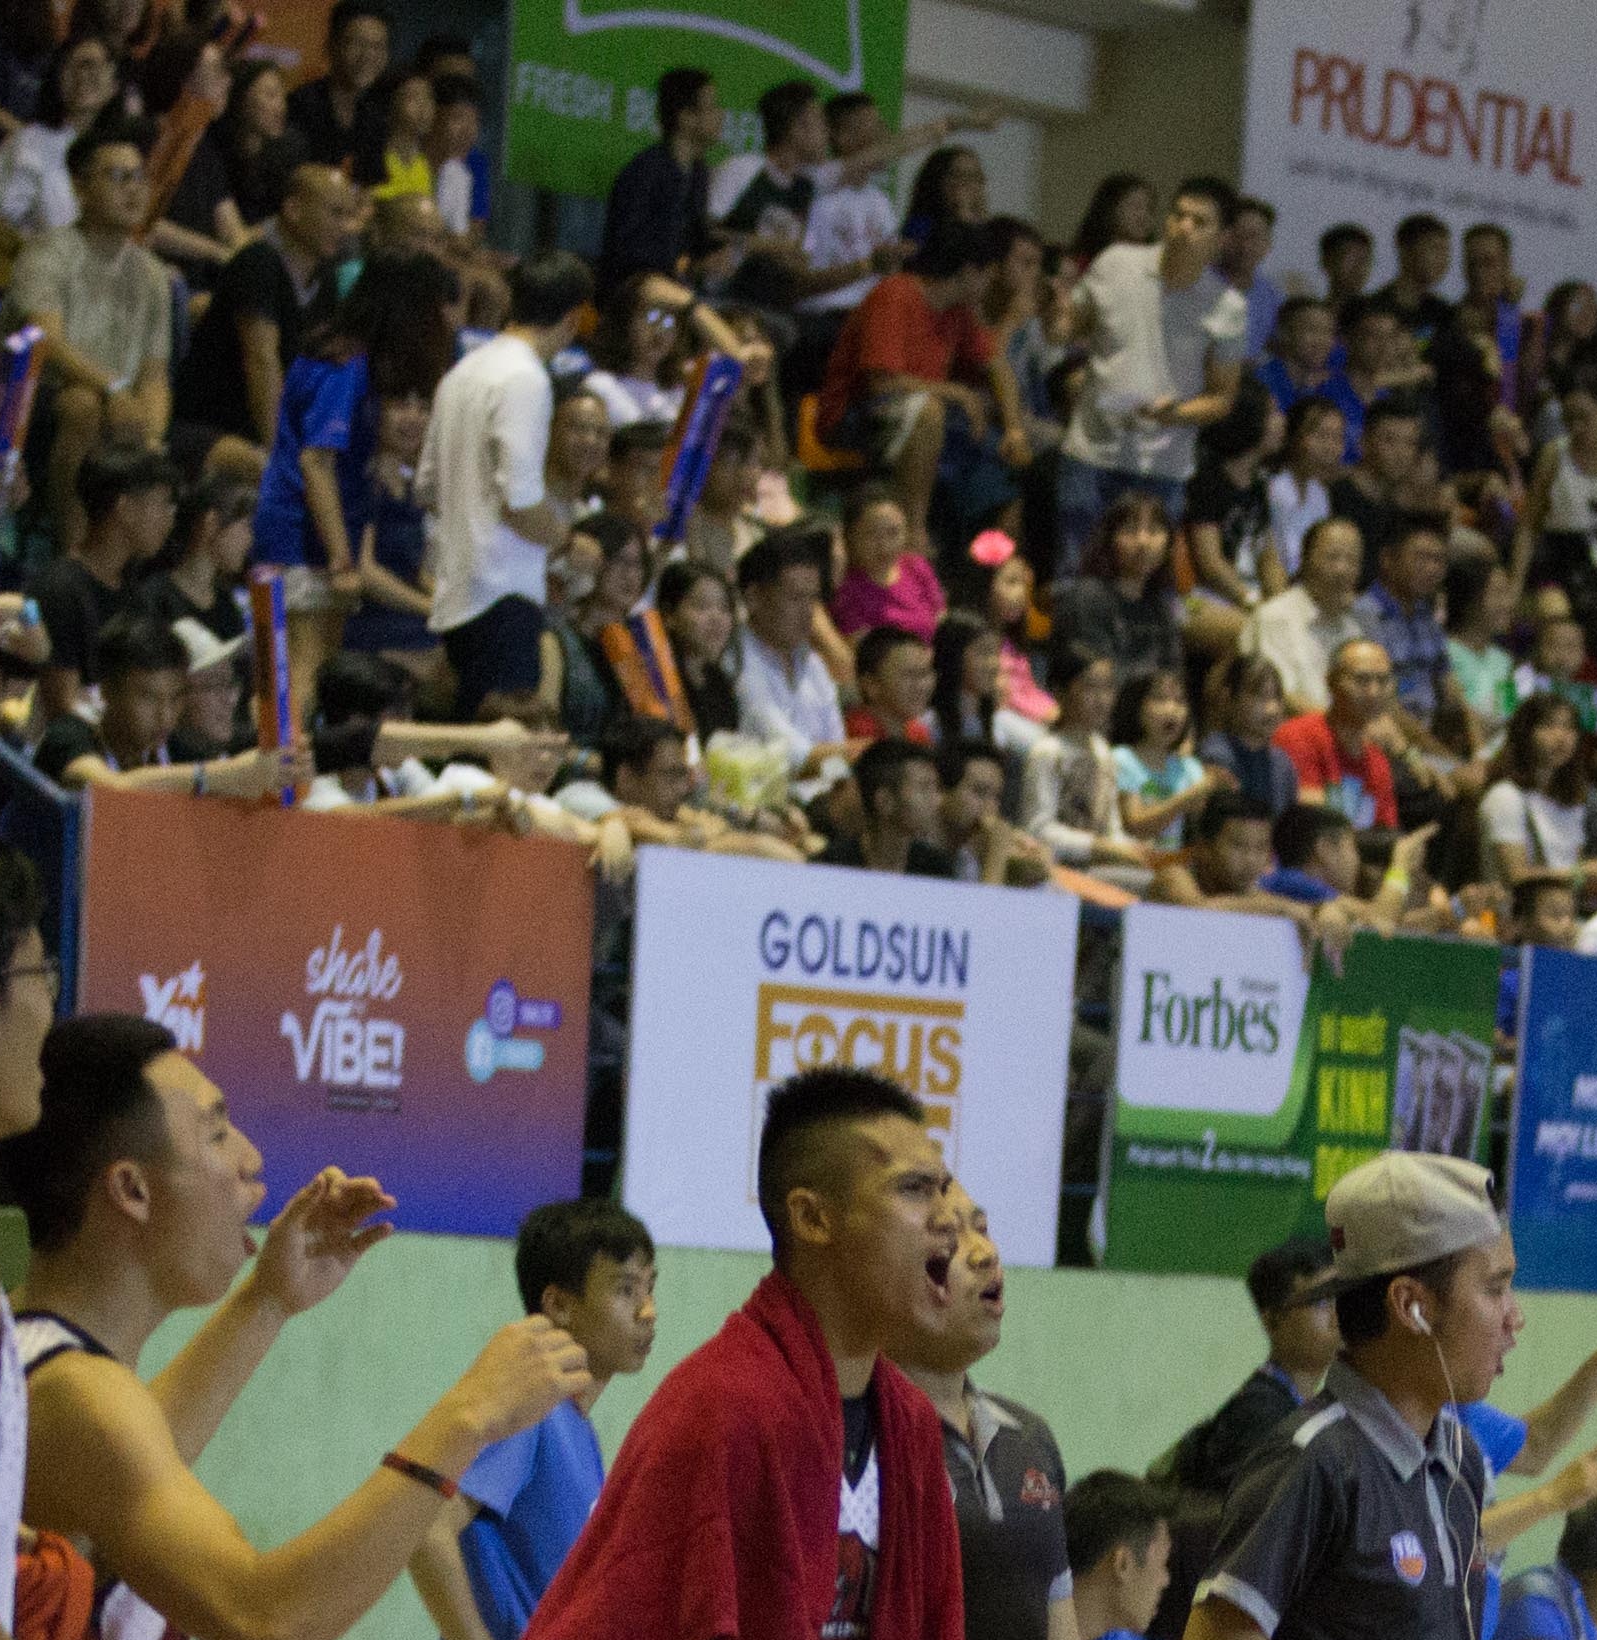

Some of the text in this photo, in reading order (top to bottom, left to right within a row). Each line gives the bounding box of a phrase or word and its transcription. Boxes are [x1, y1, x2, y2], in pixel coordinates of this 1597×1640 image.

[1289, 47, 1584, 188] PRUDENTIAL
[758, 907, 970, 989] GOLDSUN
[279, 998, 405, 1092] VIBE!
[754, 980, 965, 1097] FOCUS
[1138, 967, 1282, 1055] Forbes
